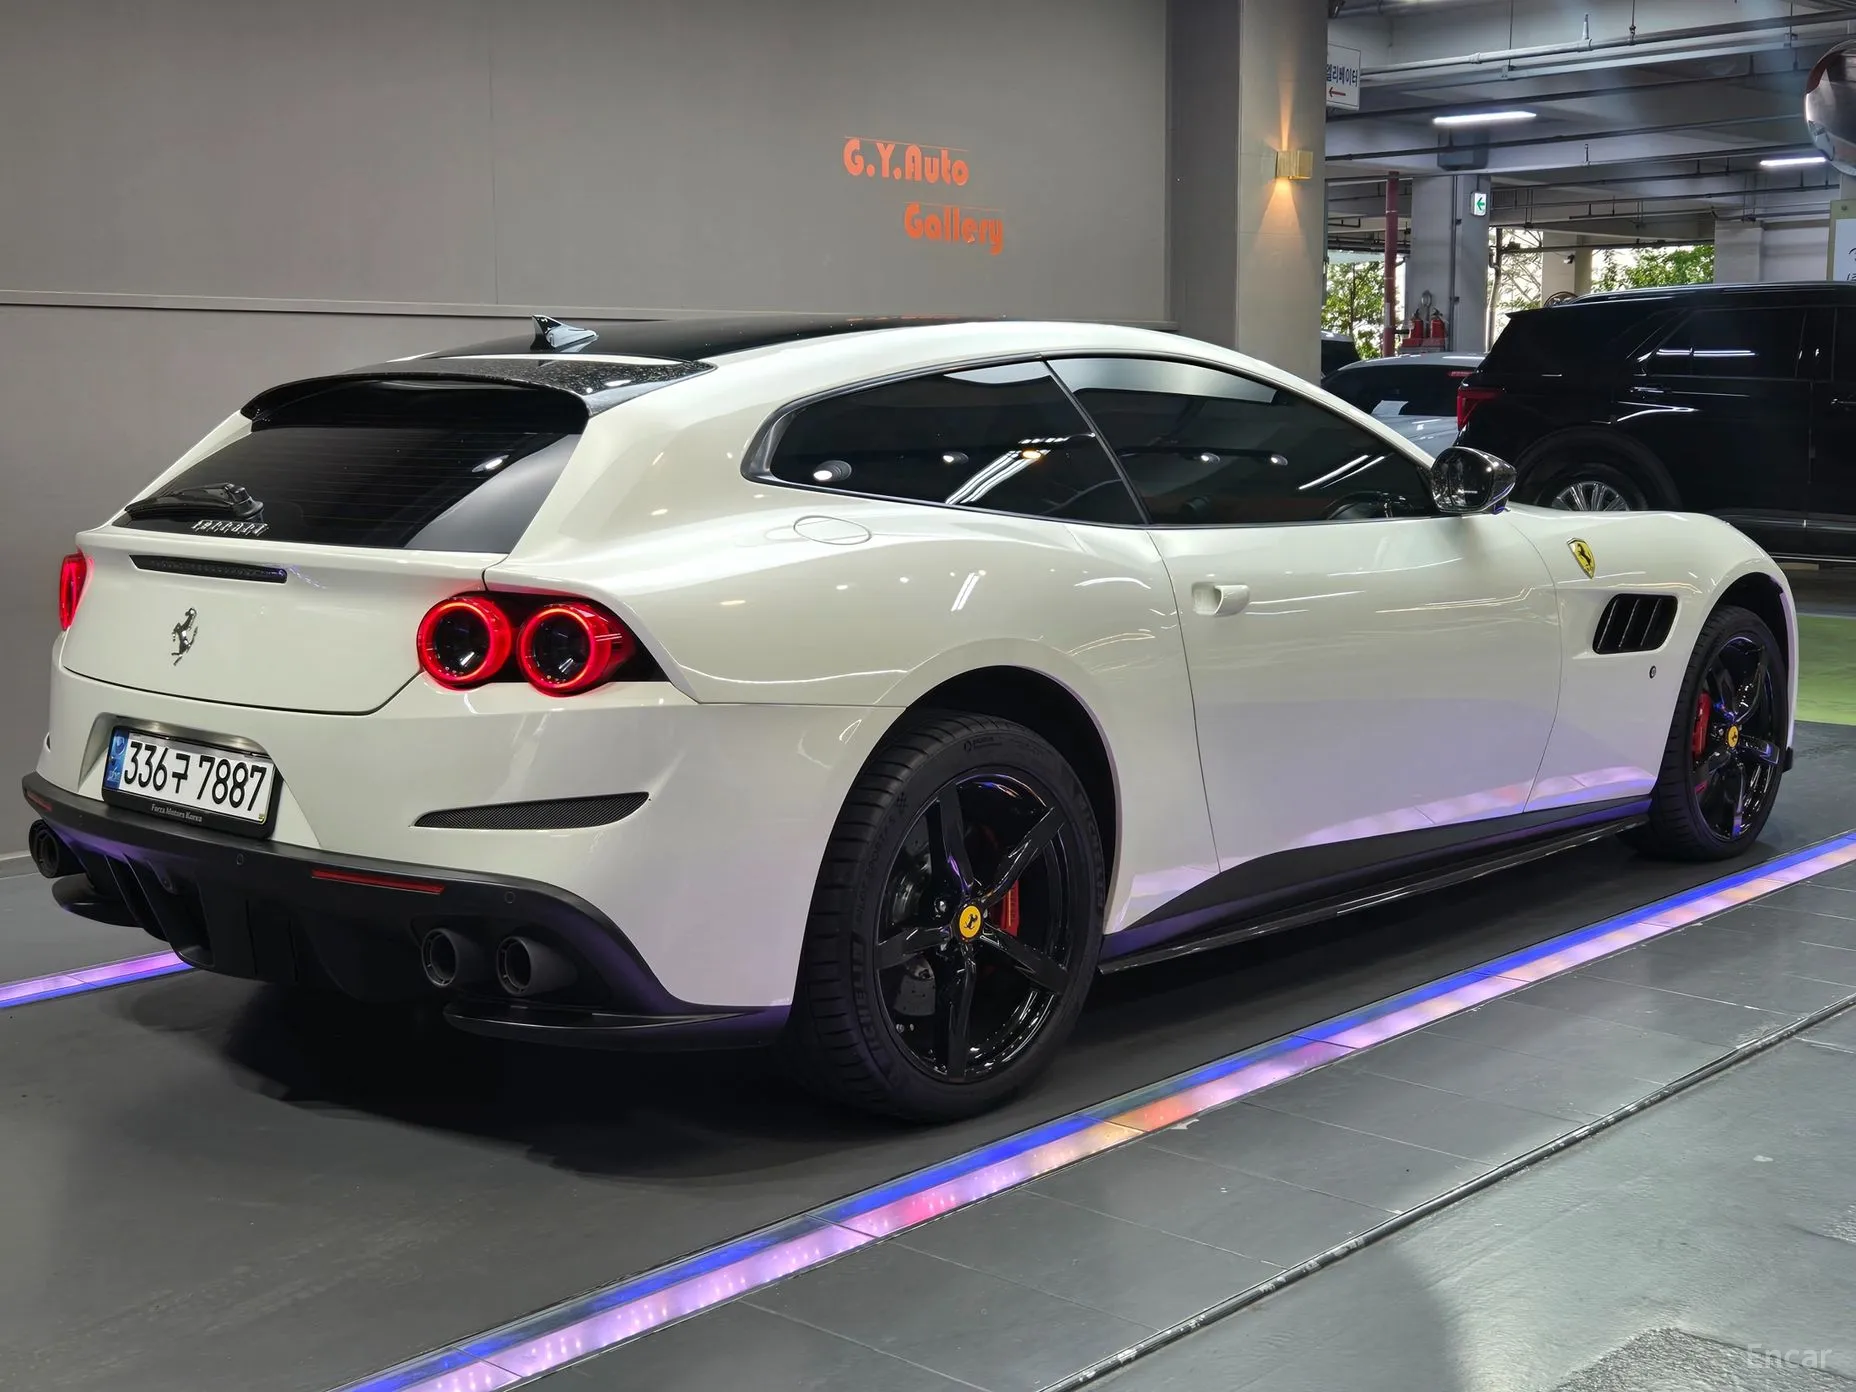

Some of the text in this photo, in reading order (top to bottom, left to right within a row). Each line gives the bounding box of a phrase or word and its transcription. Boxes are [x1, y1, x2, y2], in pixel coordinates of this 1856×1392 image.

[843, 138, 969, 186] G.Y.Auto
[904, 202, 1004, 256] Gallery
[124, 741, 267, 812] 336구 7887
